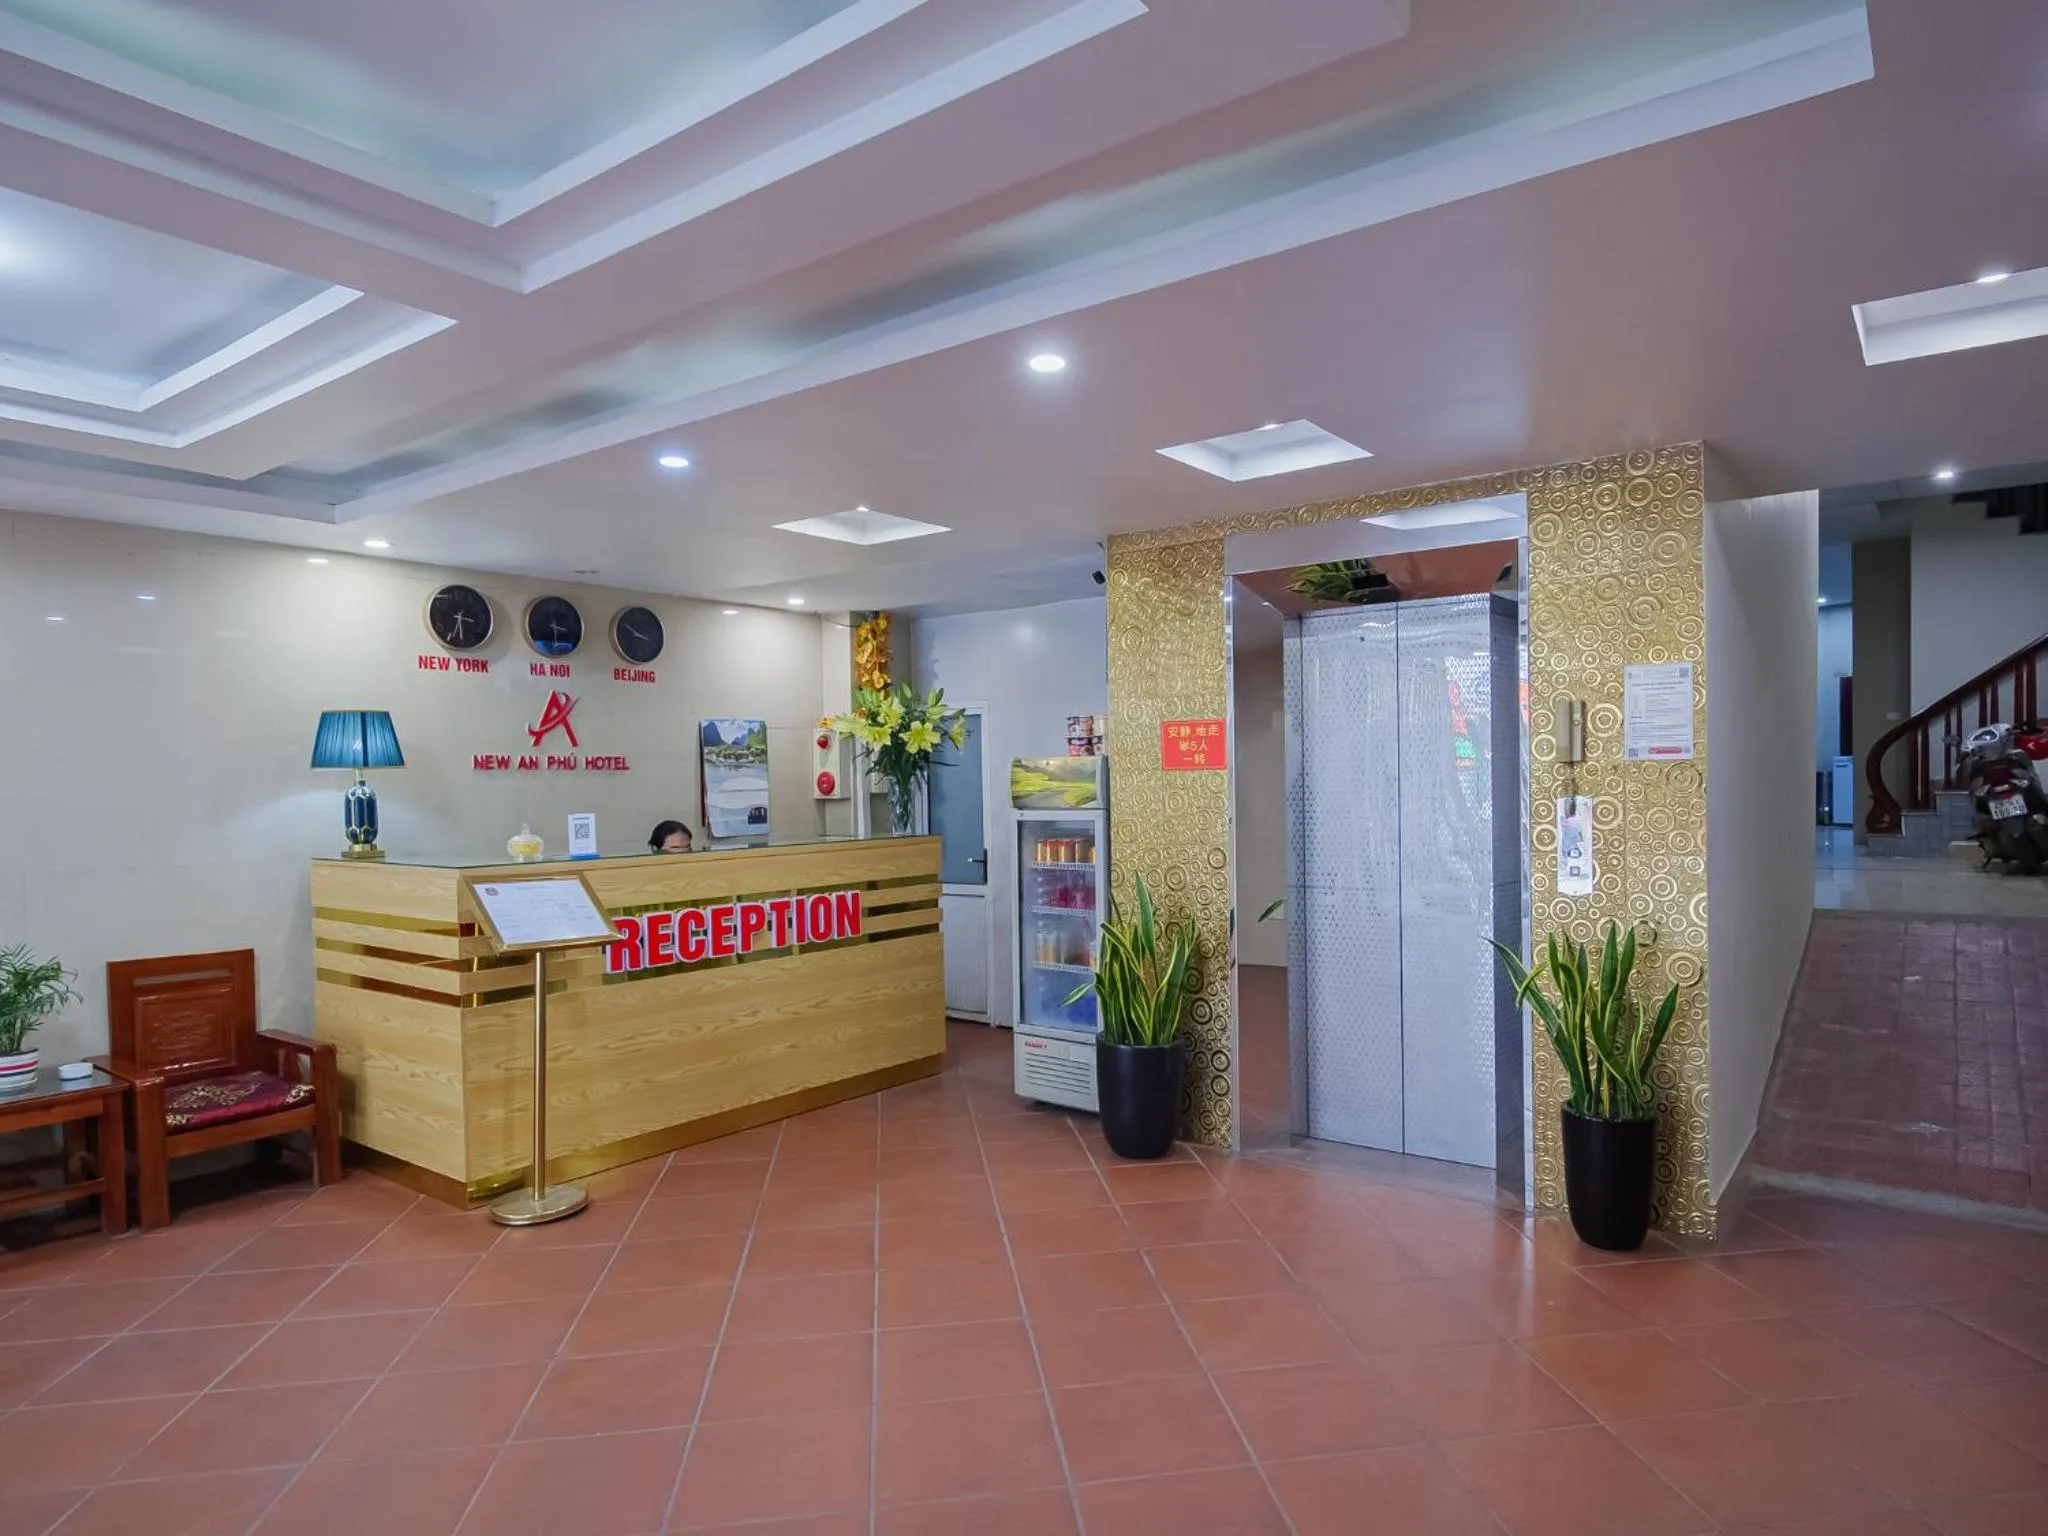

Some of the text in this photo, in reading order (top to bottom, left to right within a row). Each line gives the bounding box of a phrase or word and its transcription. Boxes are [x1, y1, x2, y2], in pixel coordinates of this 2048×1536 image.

[418, 654, 490, 674] NEW YORK
[613, 667, 657, 683] BEIJING
[473, 750, 630, 771] NEW AN PHÚ HOTEL
[605, 890, 862, 973] RECEPTION
